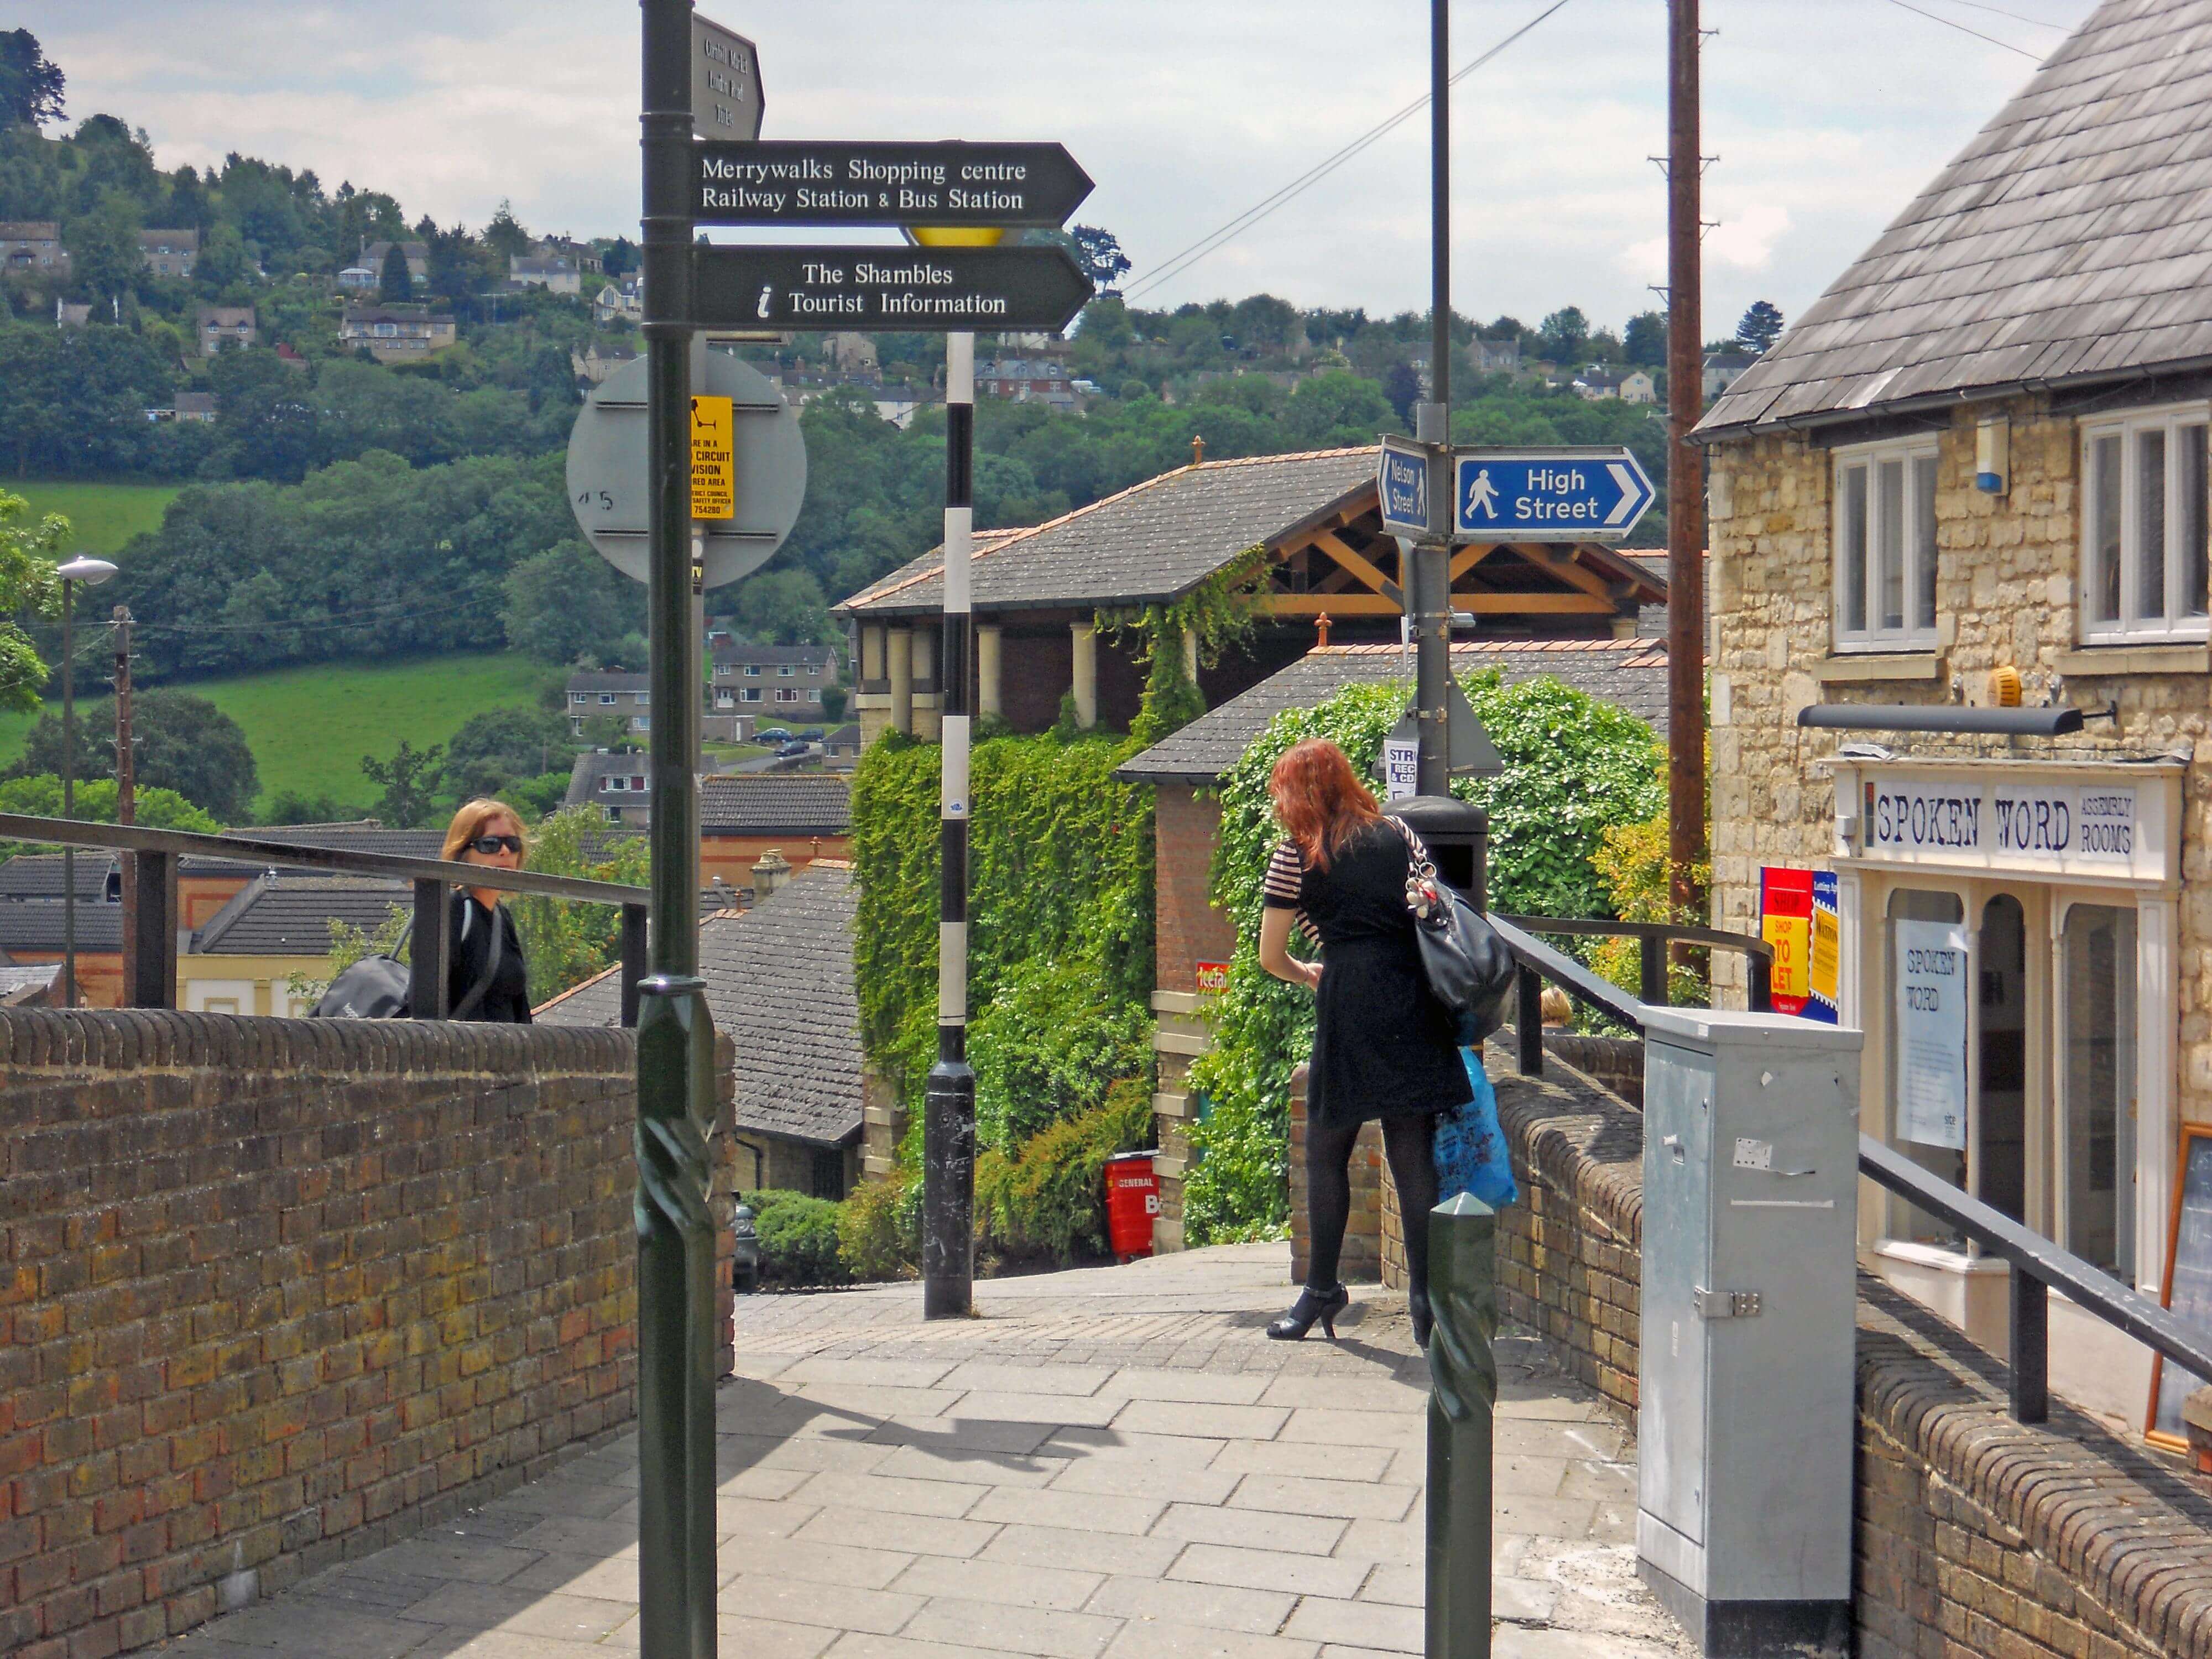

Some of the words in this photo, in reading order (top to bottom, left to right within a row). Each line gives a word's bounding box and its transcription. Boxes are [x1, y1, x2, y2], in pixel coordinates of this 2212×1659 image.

[731, 80, 743, 102] Road
[702, 159, 833, 184] Merrywalks
[848, 159, 946, 185] Shopping
[961, 162, 1026, 180] centre
[702, 188, 786, 212] Railway
[796, 189, 869, 210] Station
[878, 193, 889, 208] &
[899, 189, 938, 210] Bus
[949, 189, 1024, 210] Station
[802, 264, 843, 284] The
[855, 264, 953, 284] Shambles
[789, 293, 864, 313] Tourist
[880, 293, 1006, 314] Information
[703, 439, 711, 447] IN
[696, 451, 731, 462] CIRCUIT
[708, 478, 726, 487] AREA
[1391, 459, 1415, 486] Nelson
[1527, 469, 1585, 495] High
[1392, 491, 1413, 515] Street
[1515, 497, 1599, 519] Street
[1391, 773, 1398, 781] &
[2080, 797, 2132, 818] ASSEMBLY
[1878, 794, 1981, 847] SPOKEN
[1995, 799, 2070, 852] WORD
[2081, 823, 2131, 855] ROOMS
[1774, 892, 1800, 913] SHOP
[1775, 920, 1792, 933] SHOP
[1775, 939, 1791, 963] TO
[1907, 949, 1956, 975] SPOKEN
[1771, 966, 1792, 990] LET
[1906, 986, 1939, 1012] WORD
[1119, 1178, 1154, 1187] GENERAL
[1145, 1194, 1160, 1213] B
